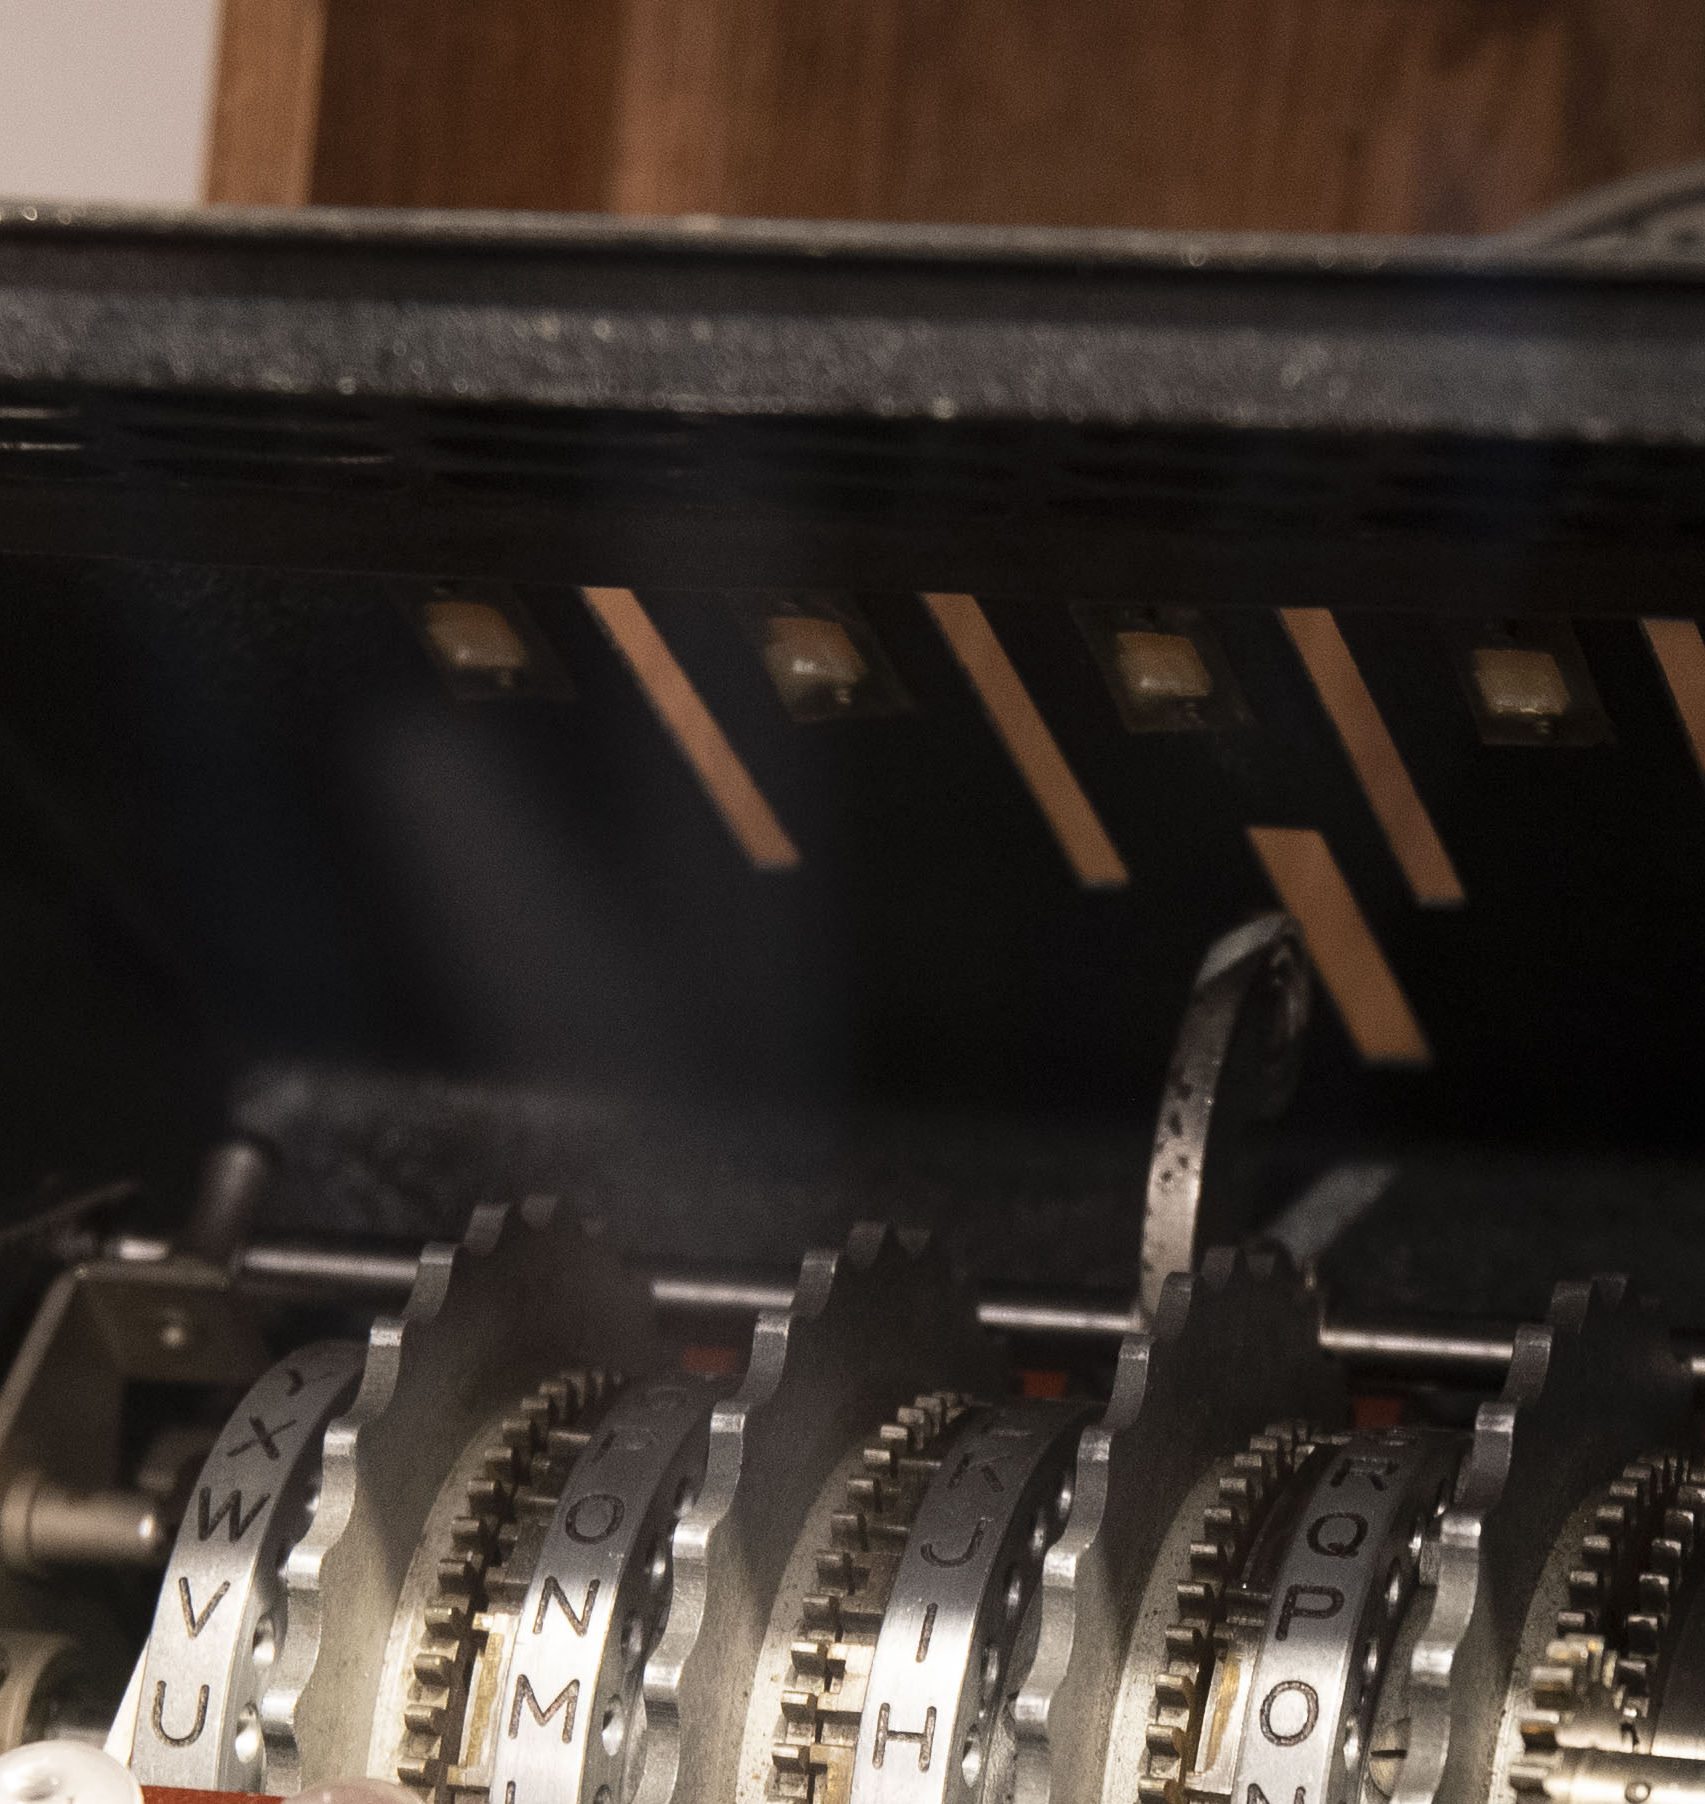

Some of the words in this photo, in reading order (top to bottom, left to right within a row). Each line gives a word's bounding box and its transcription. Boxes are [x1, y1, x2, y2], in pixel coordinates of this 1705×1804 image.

[227, 1414, 297, 1460] X
[199, 1486, 270, 1543] W
[565, 1494, 625, 1544] O
[920, 1517, 992, 1568] J
[1307, 1512, 1369, 1558] Q
[178, 1576, 231, 1639] V
[533, 1576, 601, 1637] N
[915, 1602, 939, 1662] I
[1276, 1583, 1345, 1640] P
[152, 1680, 210, 1748] U
[508, 1674, 582, 1744] M
[872, 1702, 938, 1773] H
[1260, 1680, 1319, 1747] O
